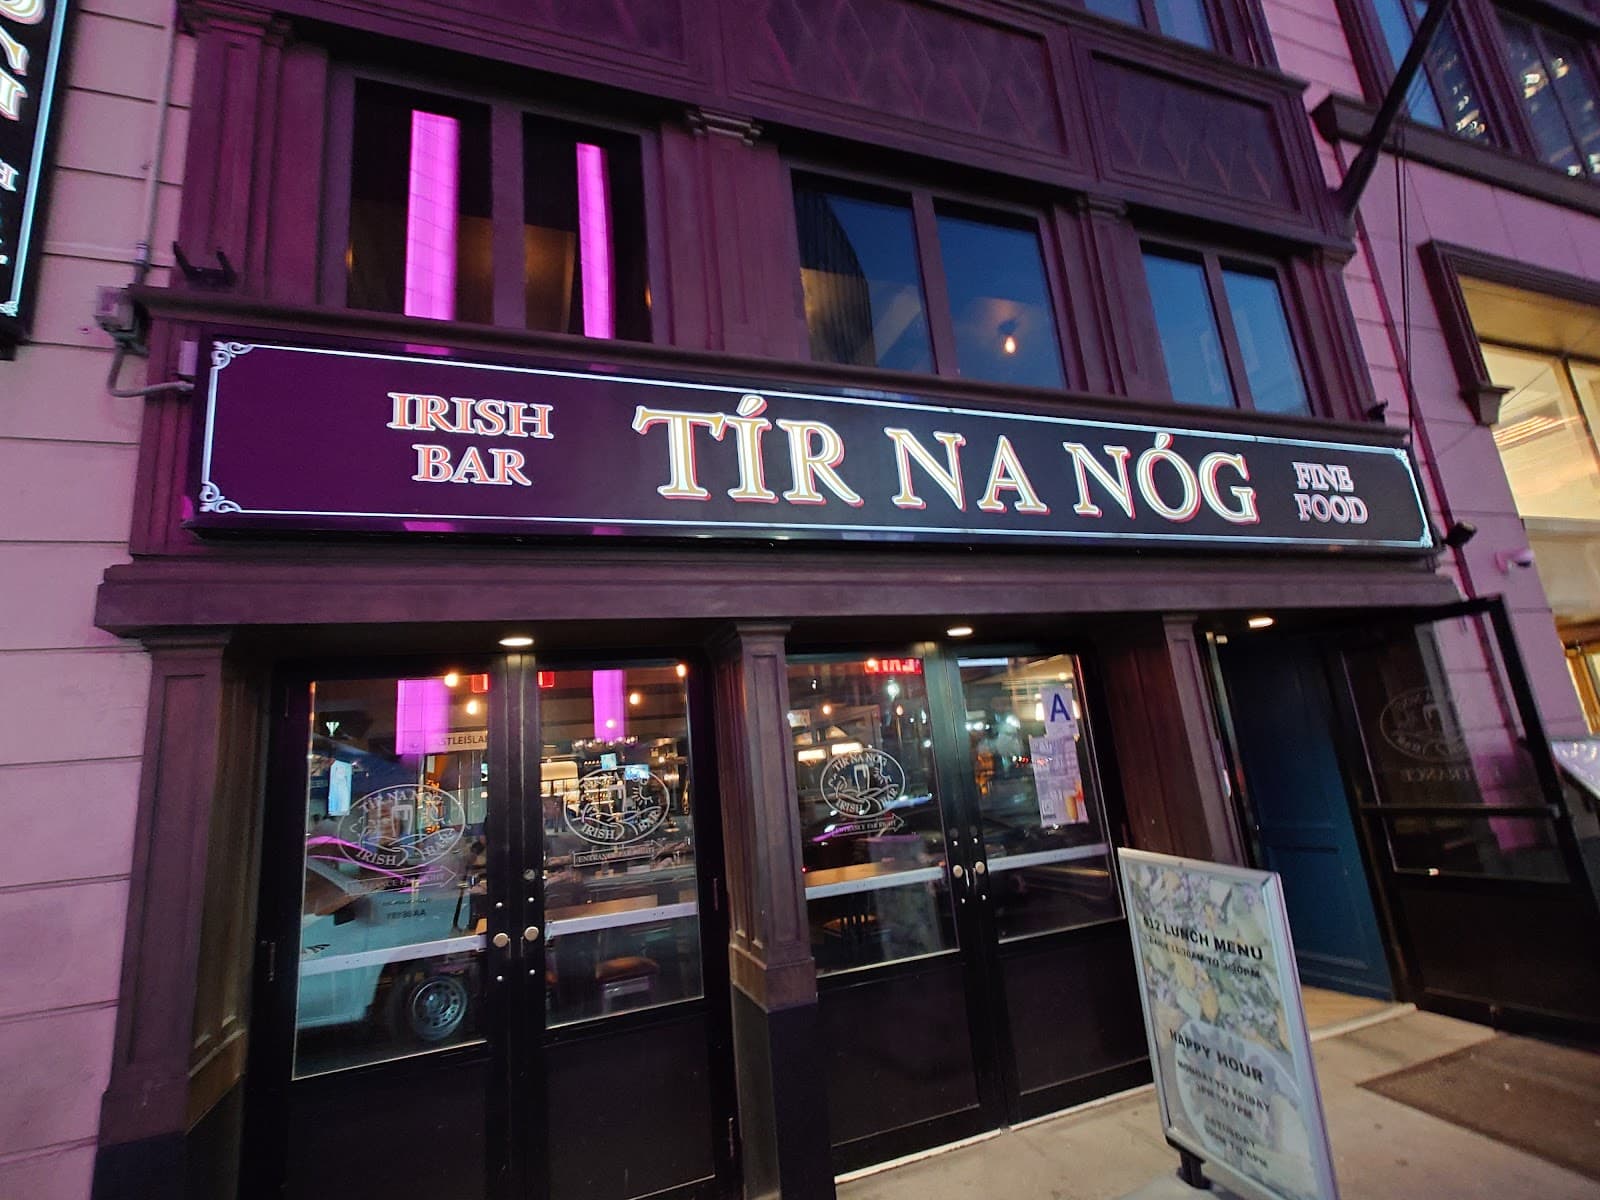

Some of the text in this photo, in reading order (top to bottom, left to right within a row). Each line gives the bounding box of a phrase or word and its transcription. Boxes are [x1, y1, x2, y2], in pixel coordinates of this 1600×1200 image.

[387, 391, 554, 440] IRISH
[411, 443, 532, 487] BAR
[632, 393, 1260, 525] TÍR NA NÓG
[1293, 461, 1354, 493] FINE
[1294, 493, 1368, 525] FOOD
[1050, 693, 1071, 722] A
[581, 823, 616, 840] IRISH
[355, 849, 397, 867] IRISH
[1163, 922, 1209, 947] LUNCH
[1213, 935, 1263, 961] MENU
[1169, 1028, 1264, 1085] HAPPY HOUR
